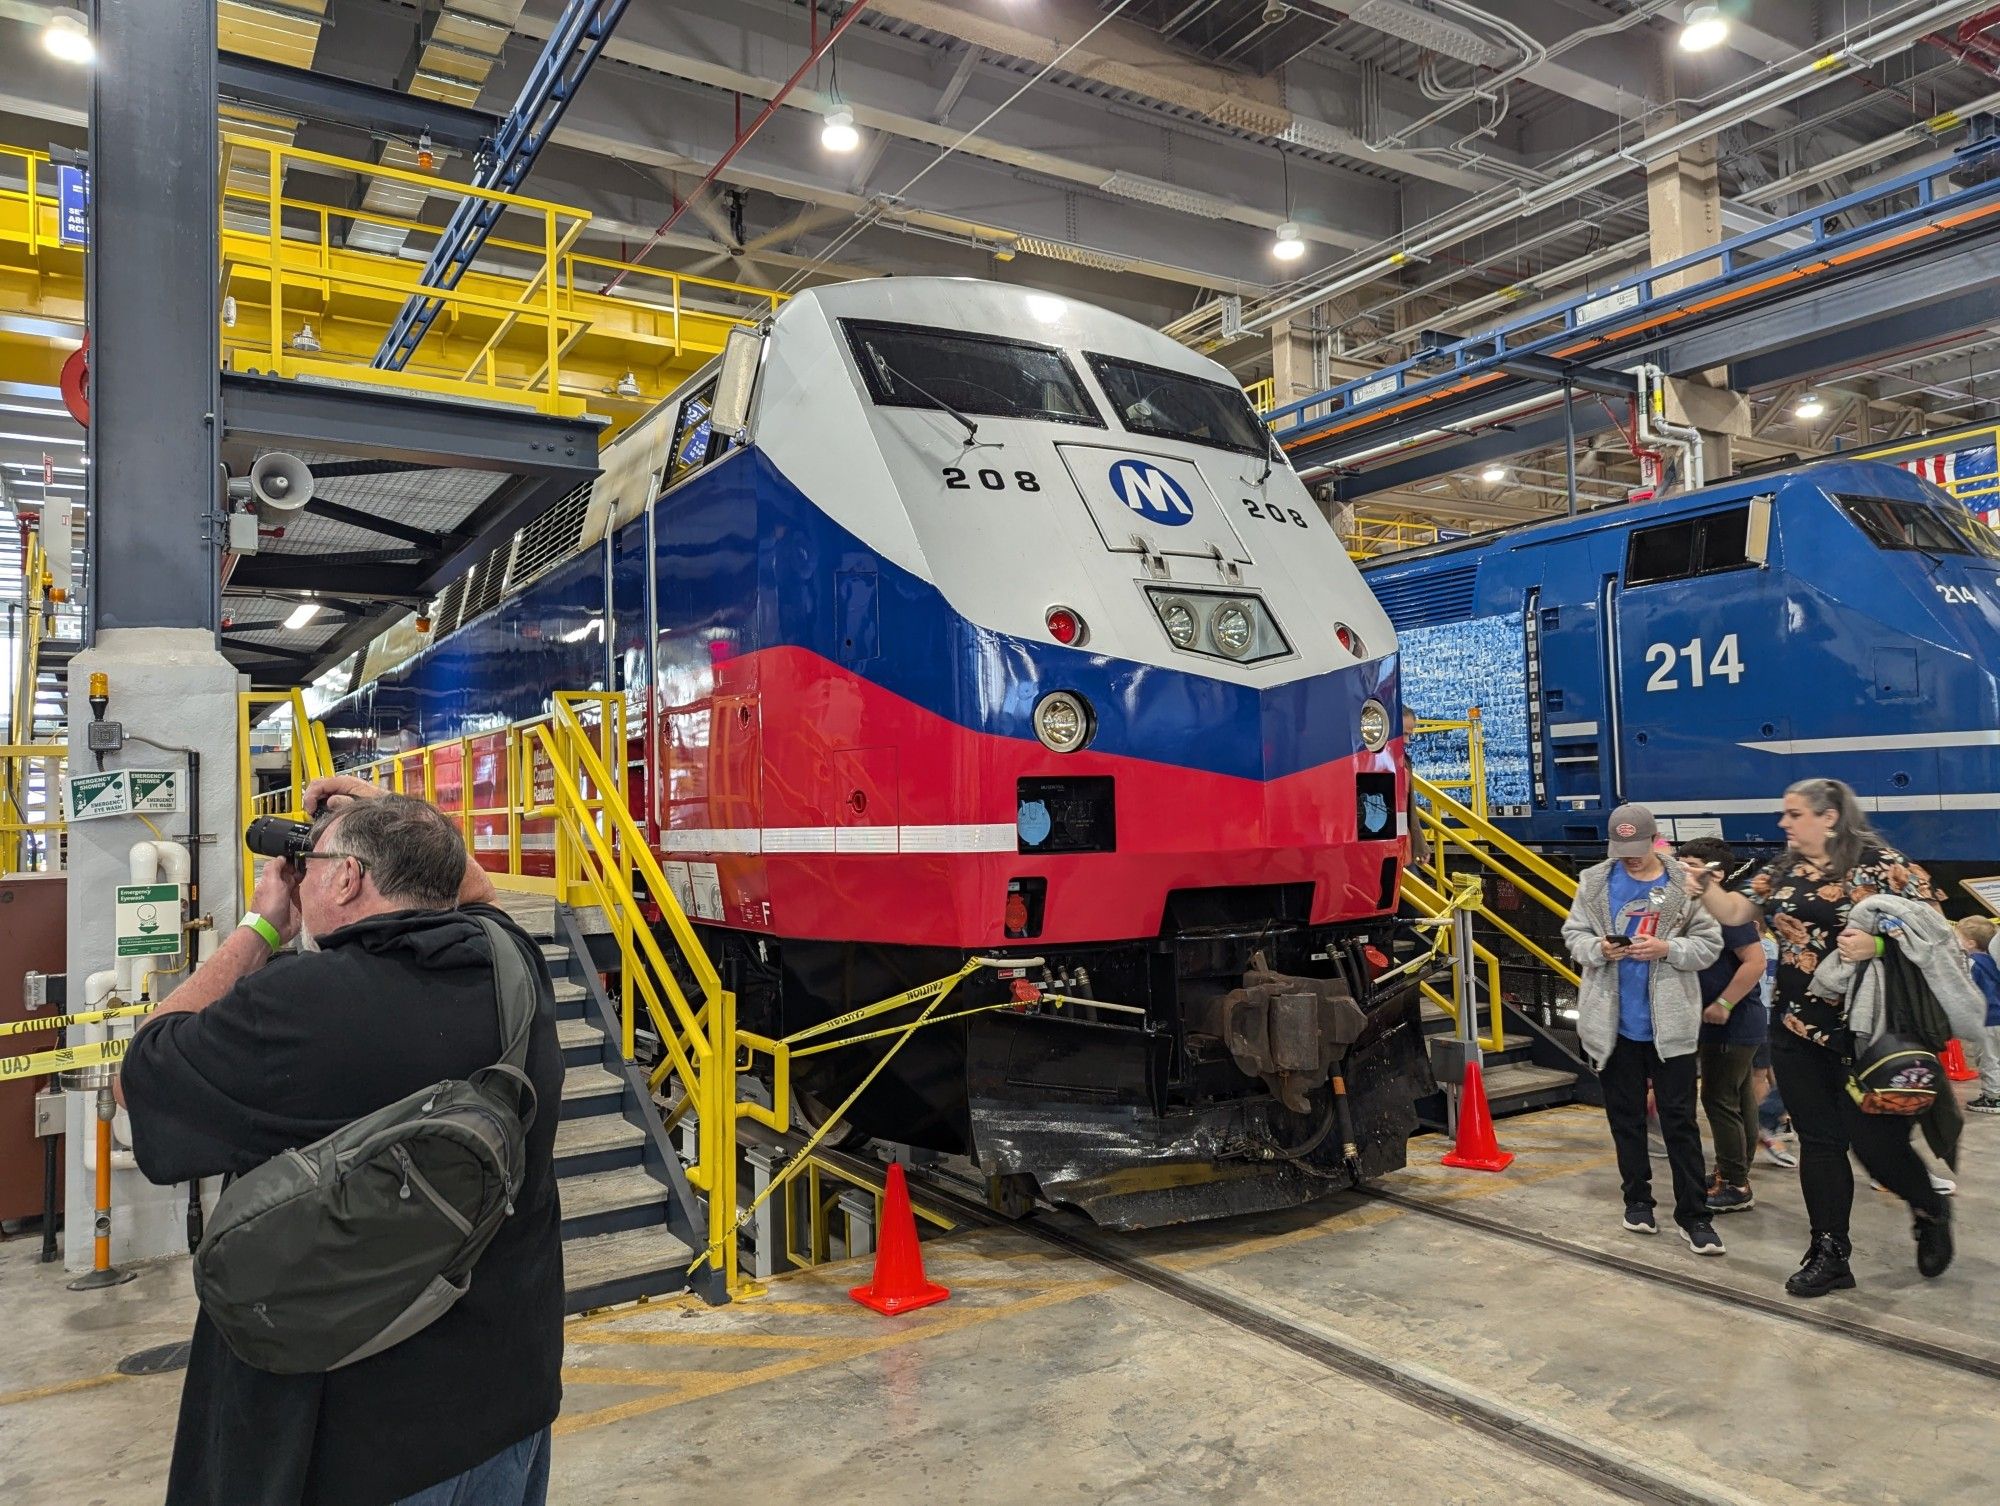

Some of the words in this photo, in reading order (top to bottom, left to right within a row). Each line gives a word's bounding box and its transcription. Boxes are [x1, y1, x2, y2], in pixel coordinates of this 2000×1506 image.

[942, 467, 1041, 493] 208
[1118, 465, 1193, 516] M
[1241, 498, 1309, 529] 208
[1935, 584, 1979, 604] 214
[1645, 633, 1745, 692] 214
[73, 776, 111, 787] EMERGENCY
[80, 782, 106, 791] SHOWER
[90, 799, 124, 809] EMERGENCY
[761, 901, 770, 926] F
[905, 981, 943, 1001] CAUTION
[12, 1015, 75, 1035] CAUTION
